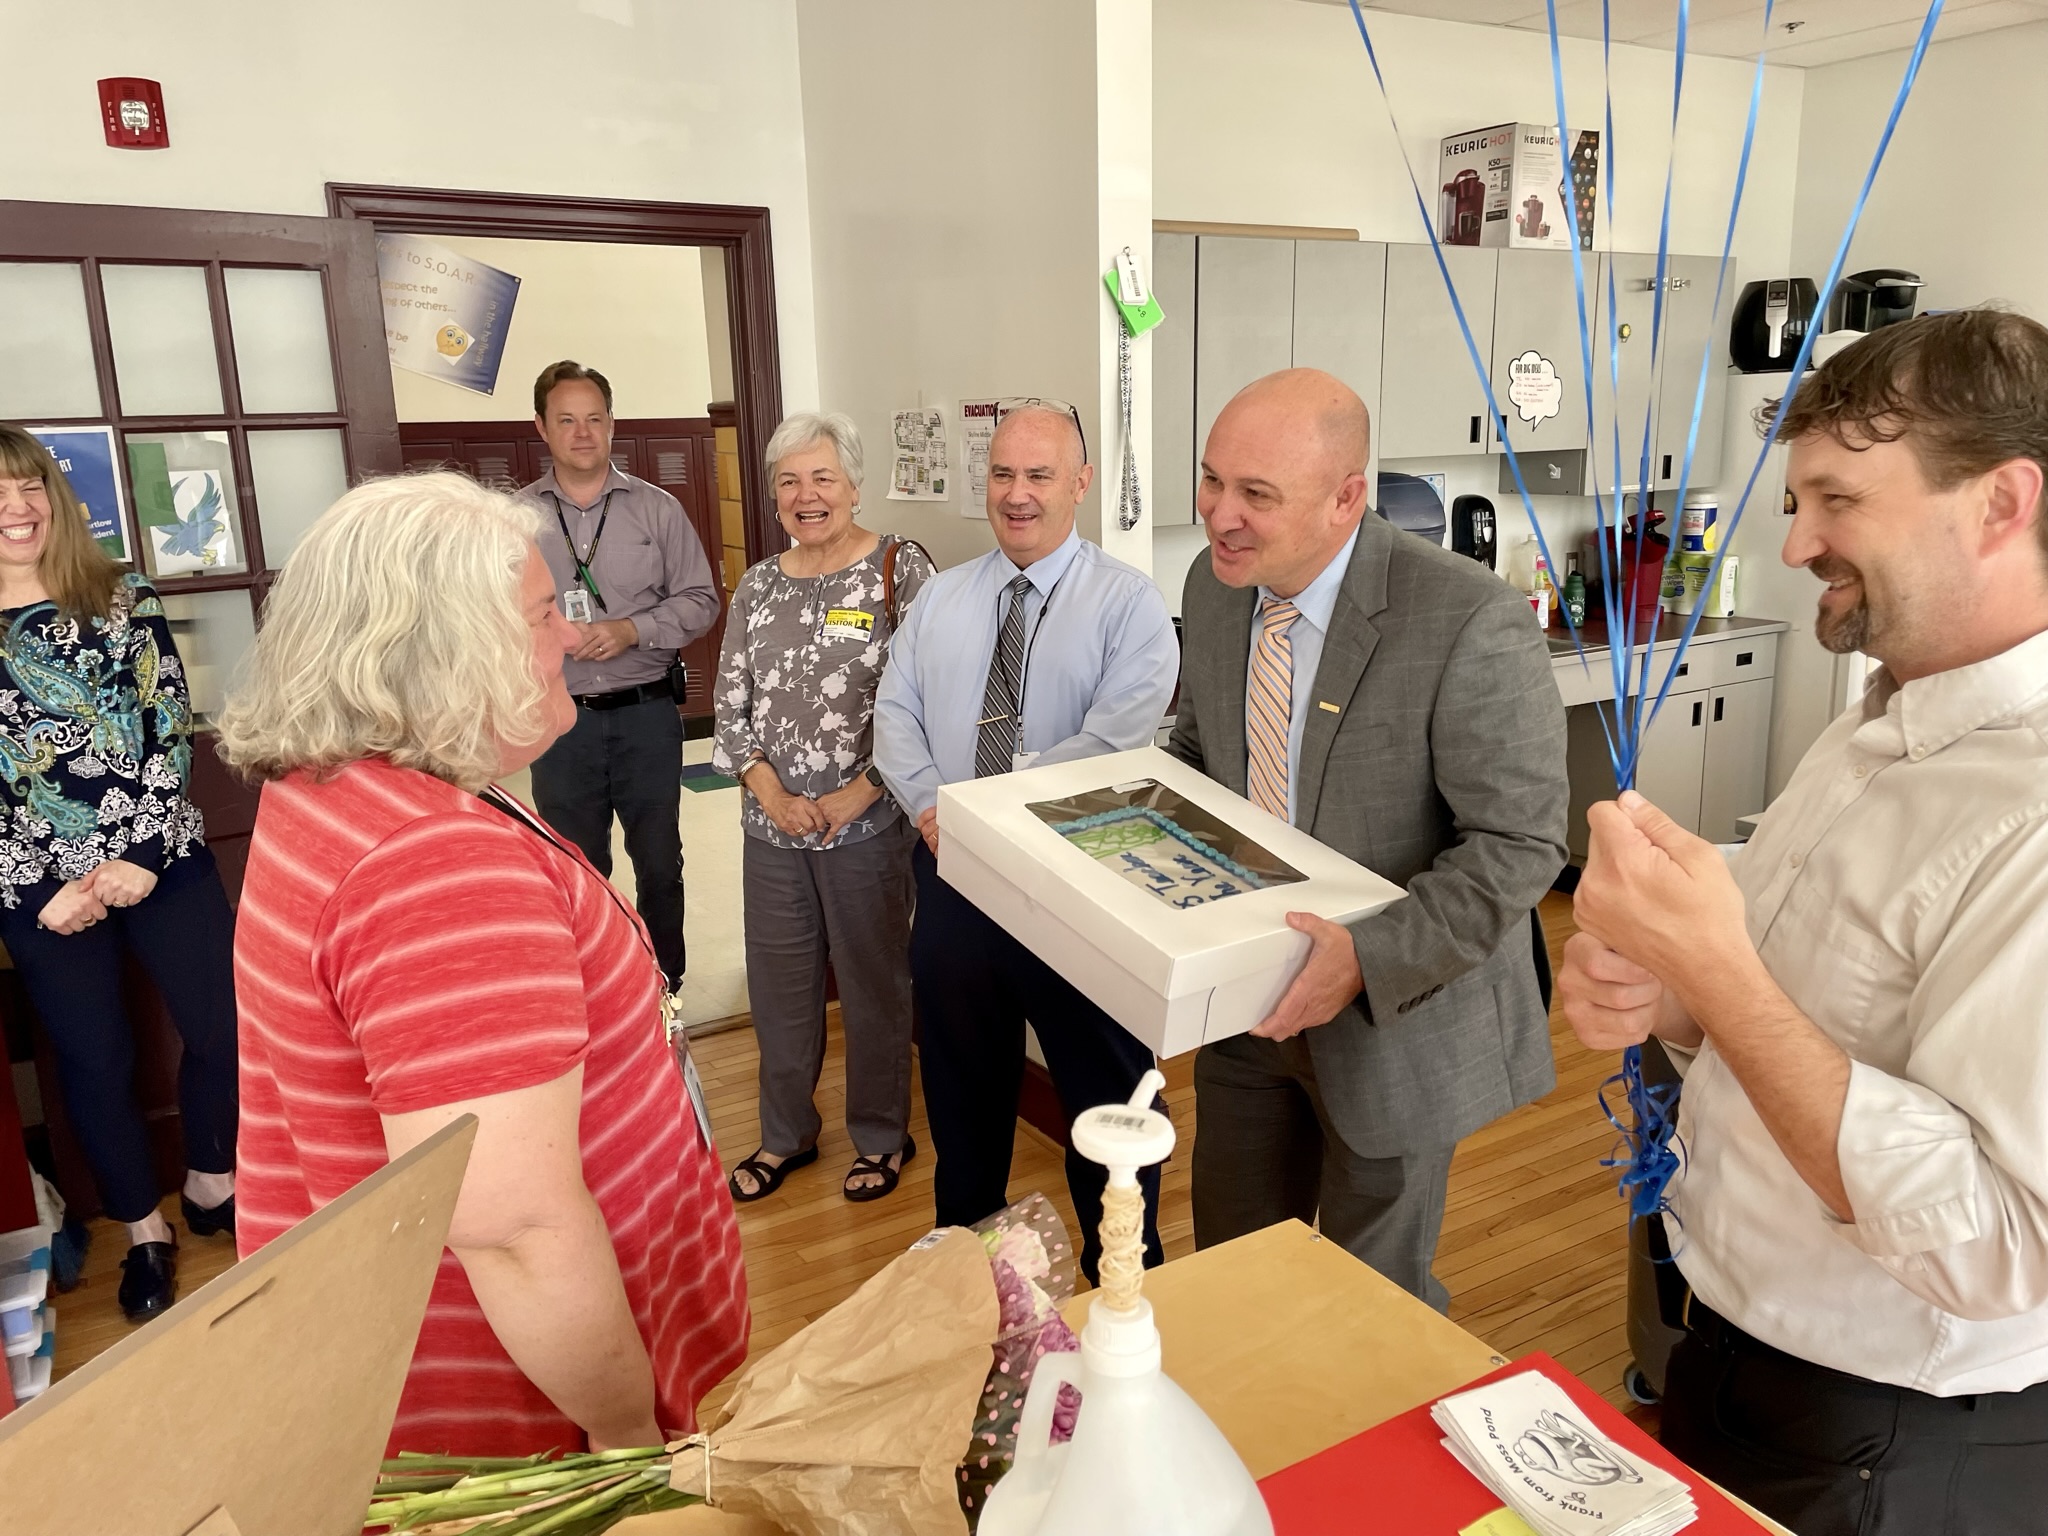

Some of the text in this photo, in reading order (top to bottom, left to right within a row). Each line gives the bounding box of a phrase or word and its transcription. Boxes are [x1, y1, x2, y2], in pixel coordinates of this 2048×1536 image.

[107, 101, 117, 132] FIRE
[151, 102, 161, 133] FIRE
[1445, 132, 1513, 157] KEURIG HOT
[1523, 134, 1554, 146] KEURIG
[407, 251, 421, 265] to
[381, 280, 438, 294] espect the
[399, 299, 413, 309] of
[484, 312, 497, 329] the
[395, 332, 409, 343] be
[473, 330, 493, 368] hallway
[964, 403, 997, 417] EVACUATIO
[58, 458, 73, 473] RT
[92, 529, 116, 539] ident
[825, 619, 854, 627] VISITOR
[1479, 1407, 1603, 1520] Frank from Moss Pond
